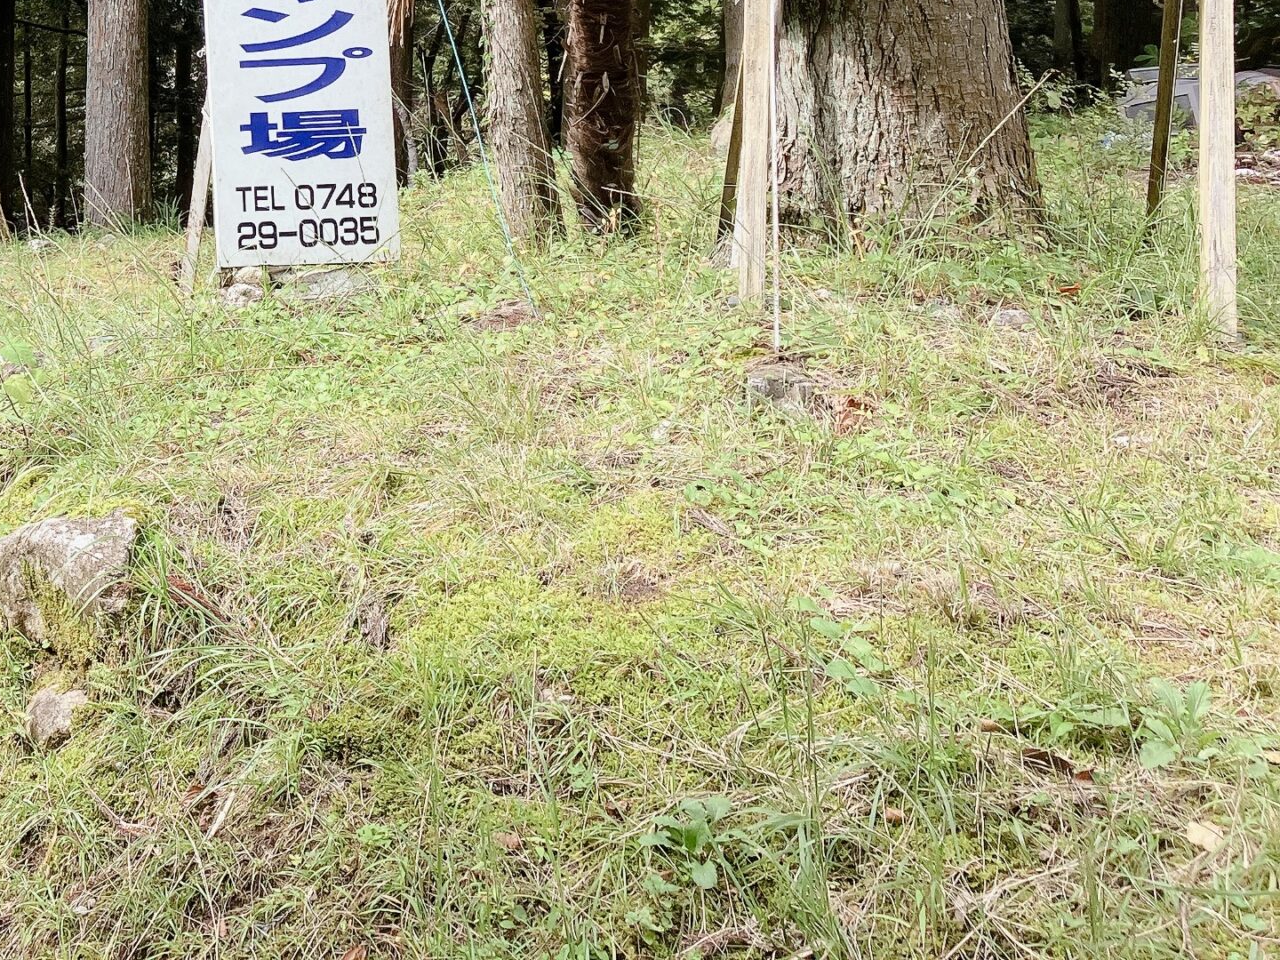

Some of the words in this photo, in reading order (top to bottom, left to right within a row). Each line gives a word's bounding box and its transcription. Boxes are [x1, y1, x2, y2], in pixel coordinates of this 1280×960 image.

[235, 185, 286, 213] TEL
[294, 182, 378, 211] 0748
[236, 215, 380, 251] 29-0035
